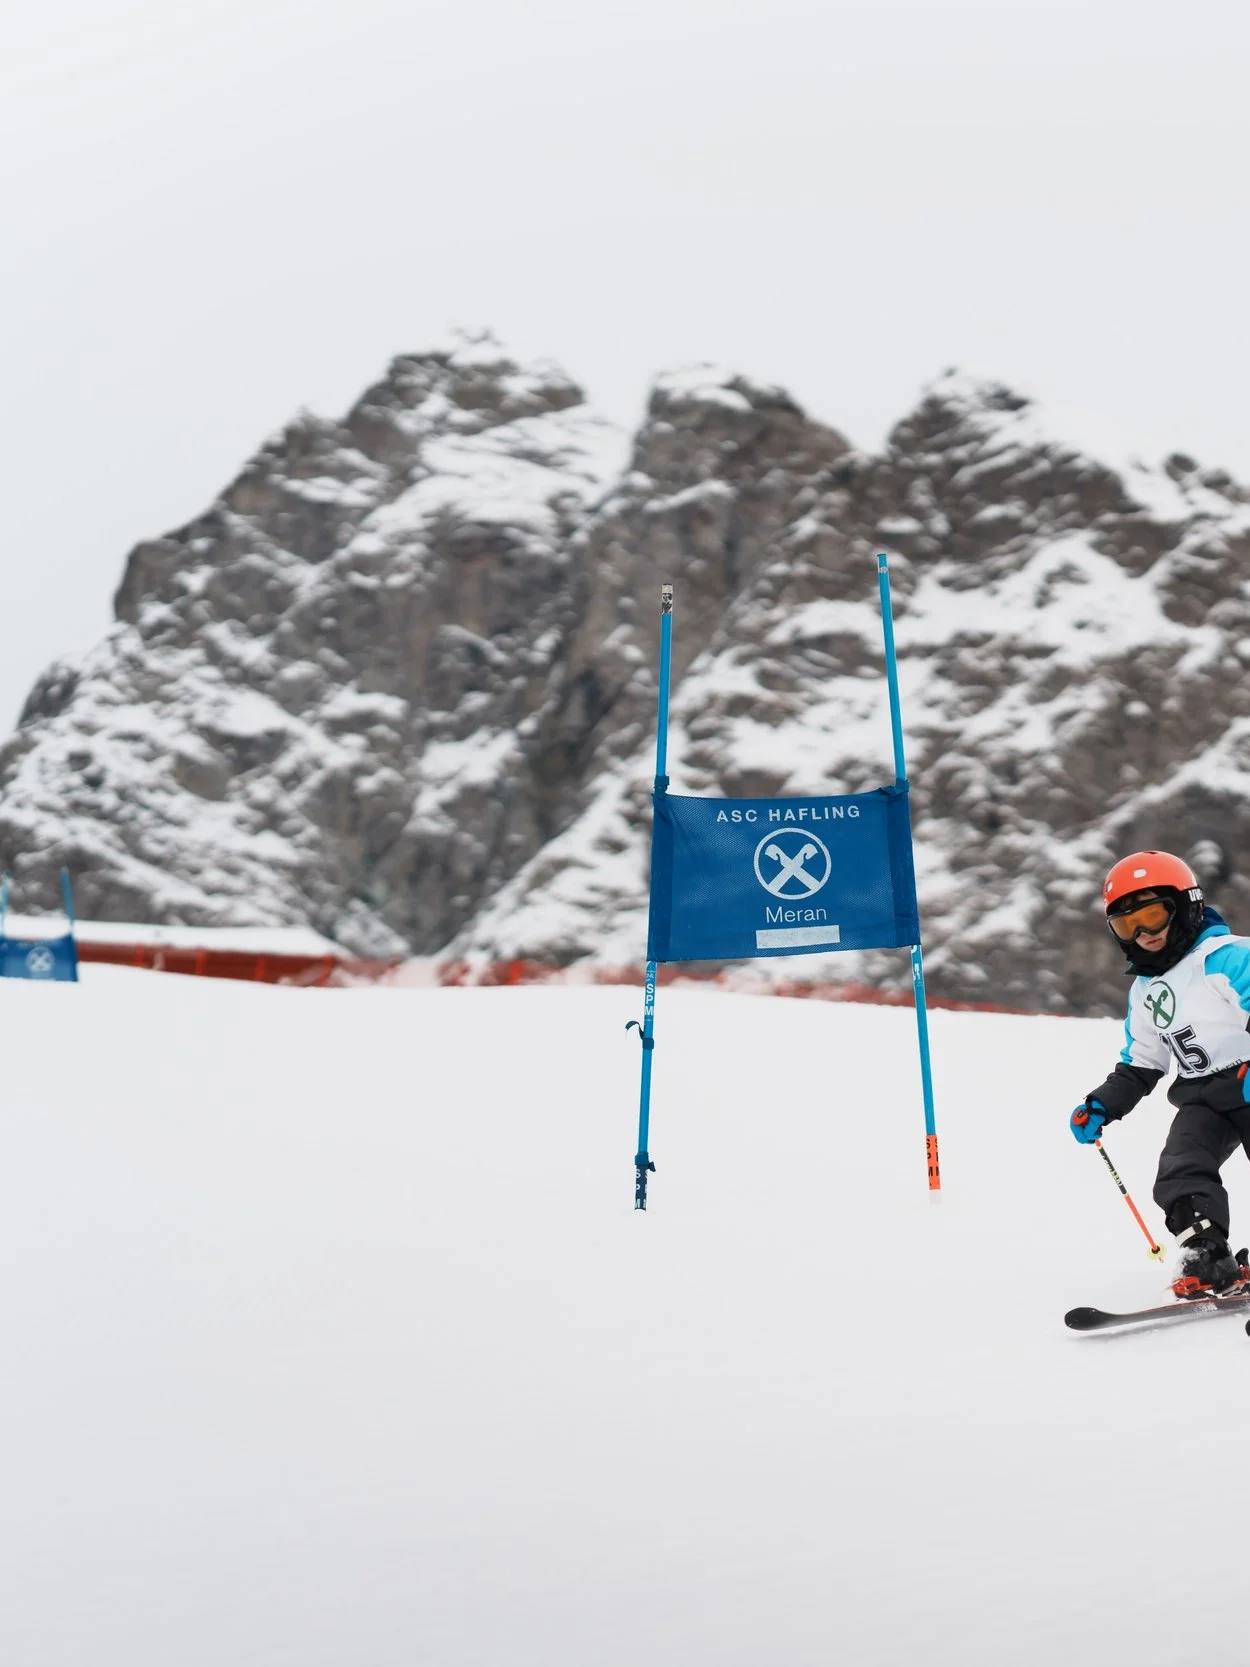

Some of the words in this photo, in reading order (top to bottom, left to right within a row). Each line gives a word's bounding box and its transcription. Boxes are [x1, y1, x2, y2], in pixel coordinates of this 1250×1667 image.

[716, 809, 758, 823] ASC
[768, 805, 860, 822] HAFLING
[765, 906, 827, 923] Meran
[1159, 1025, 1212, 1075] 15
